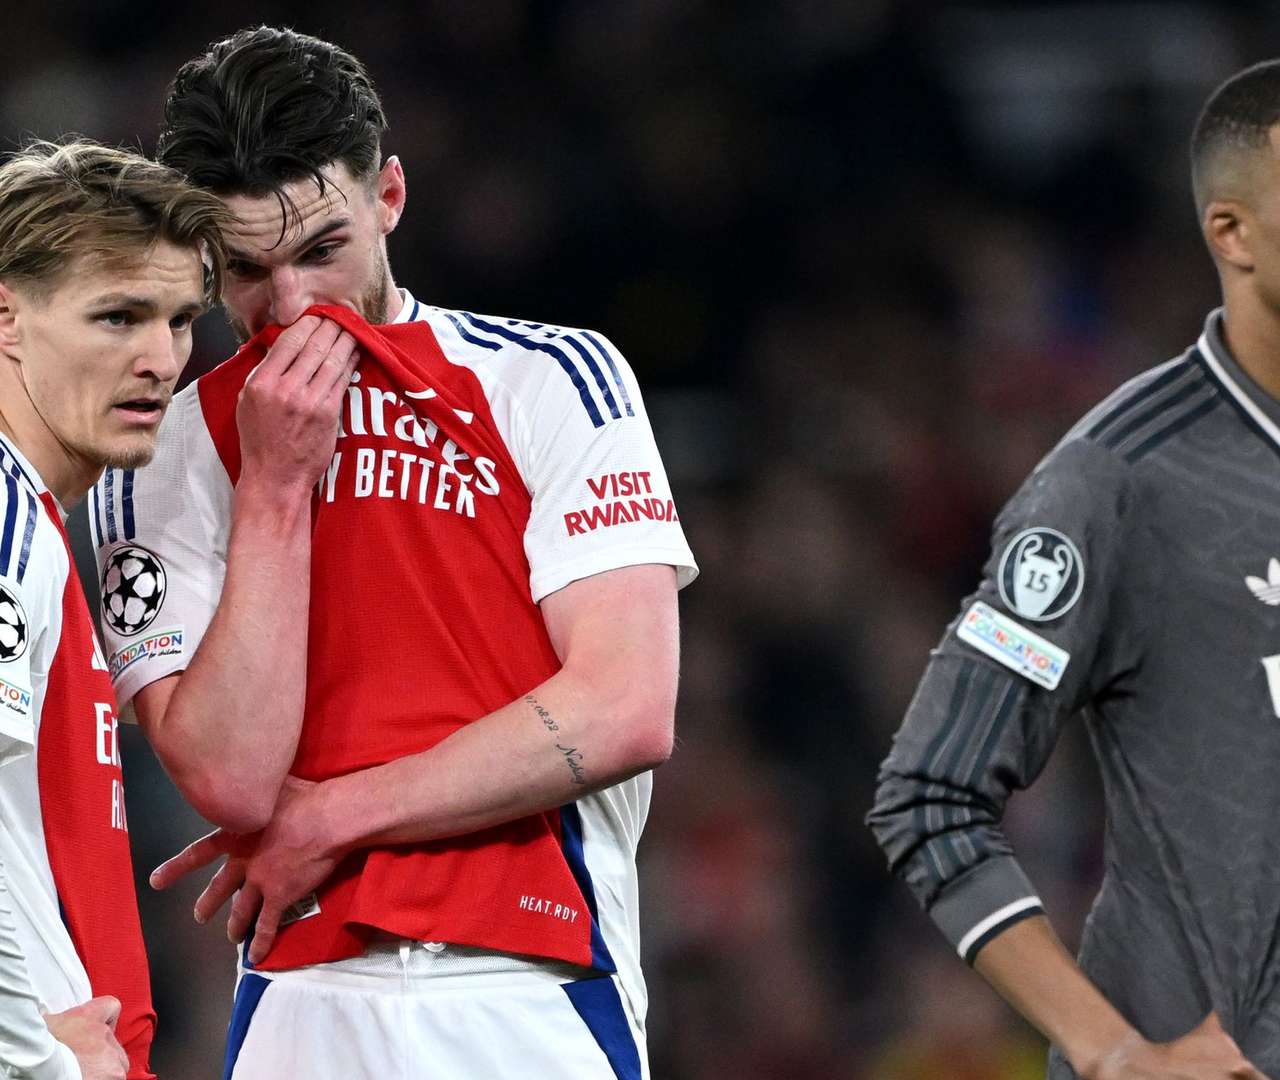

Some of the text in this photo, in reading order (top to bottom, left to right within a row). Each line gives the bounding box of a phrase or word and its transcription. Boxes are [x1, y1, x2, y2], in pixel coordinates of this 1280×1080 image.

[336, 370, 501, 496] iraes
[586, 471, 652, 500] VISIT
[564, 498, 680, 537] RWANDA
[1025, 570, 1051, 592] 15
[109, 634, 183, 674] UNDATION
[519, 895, 578, 923] HEAT.RDY
